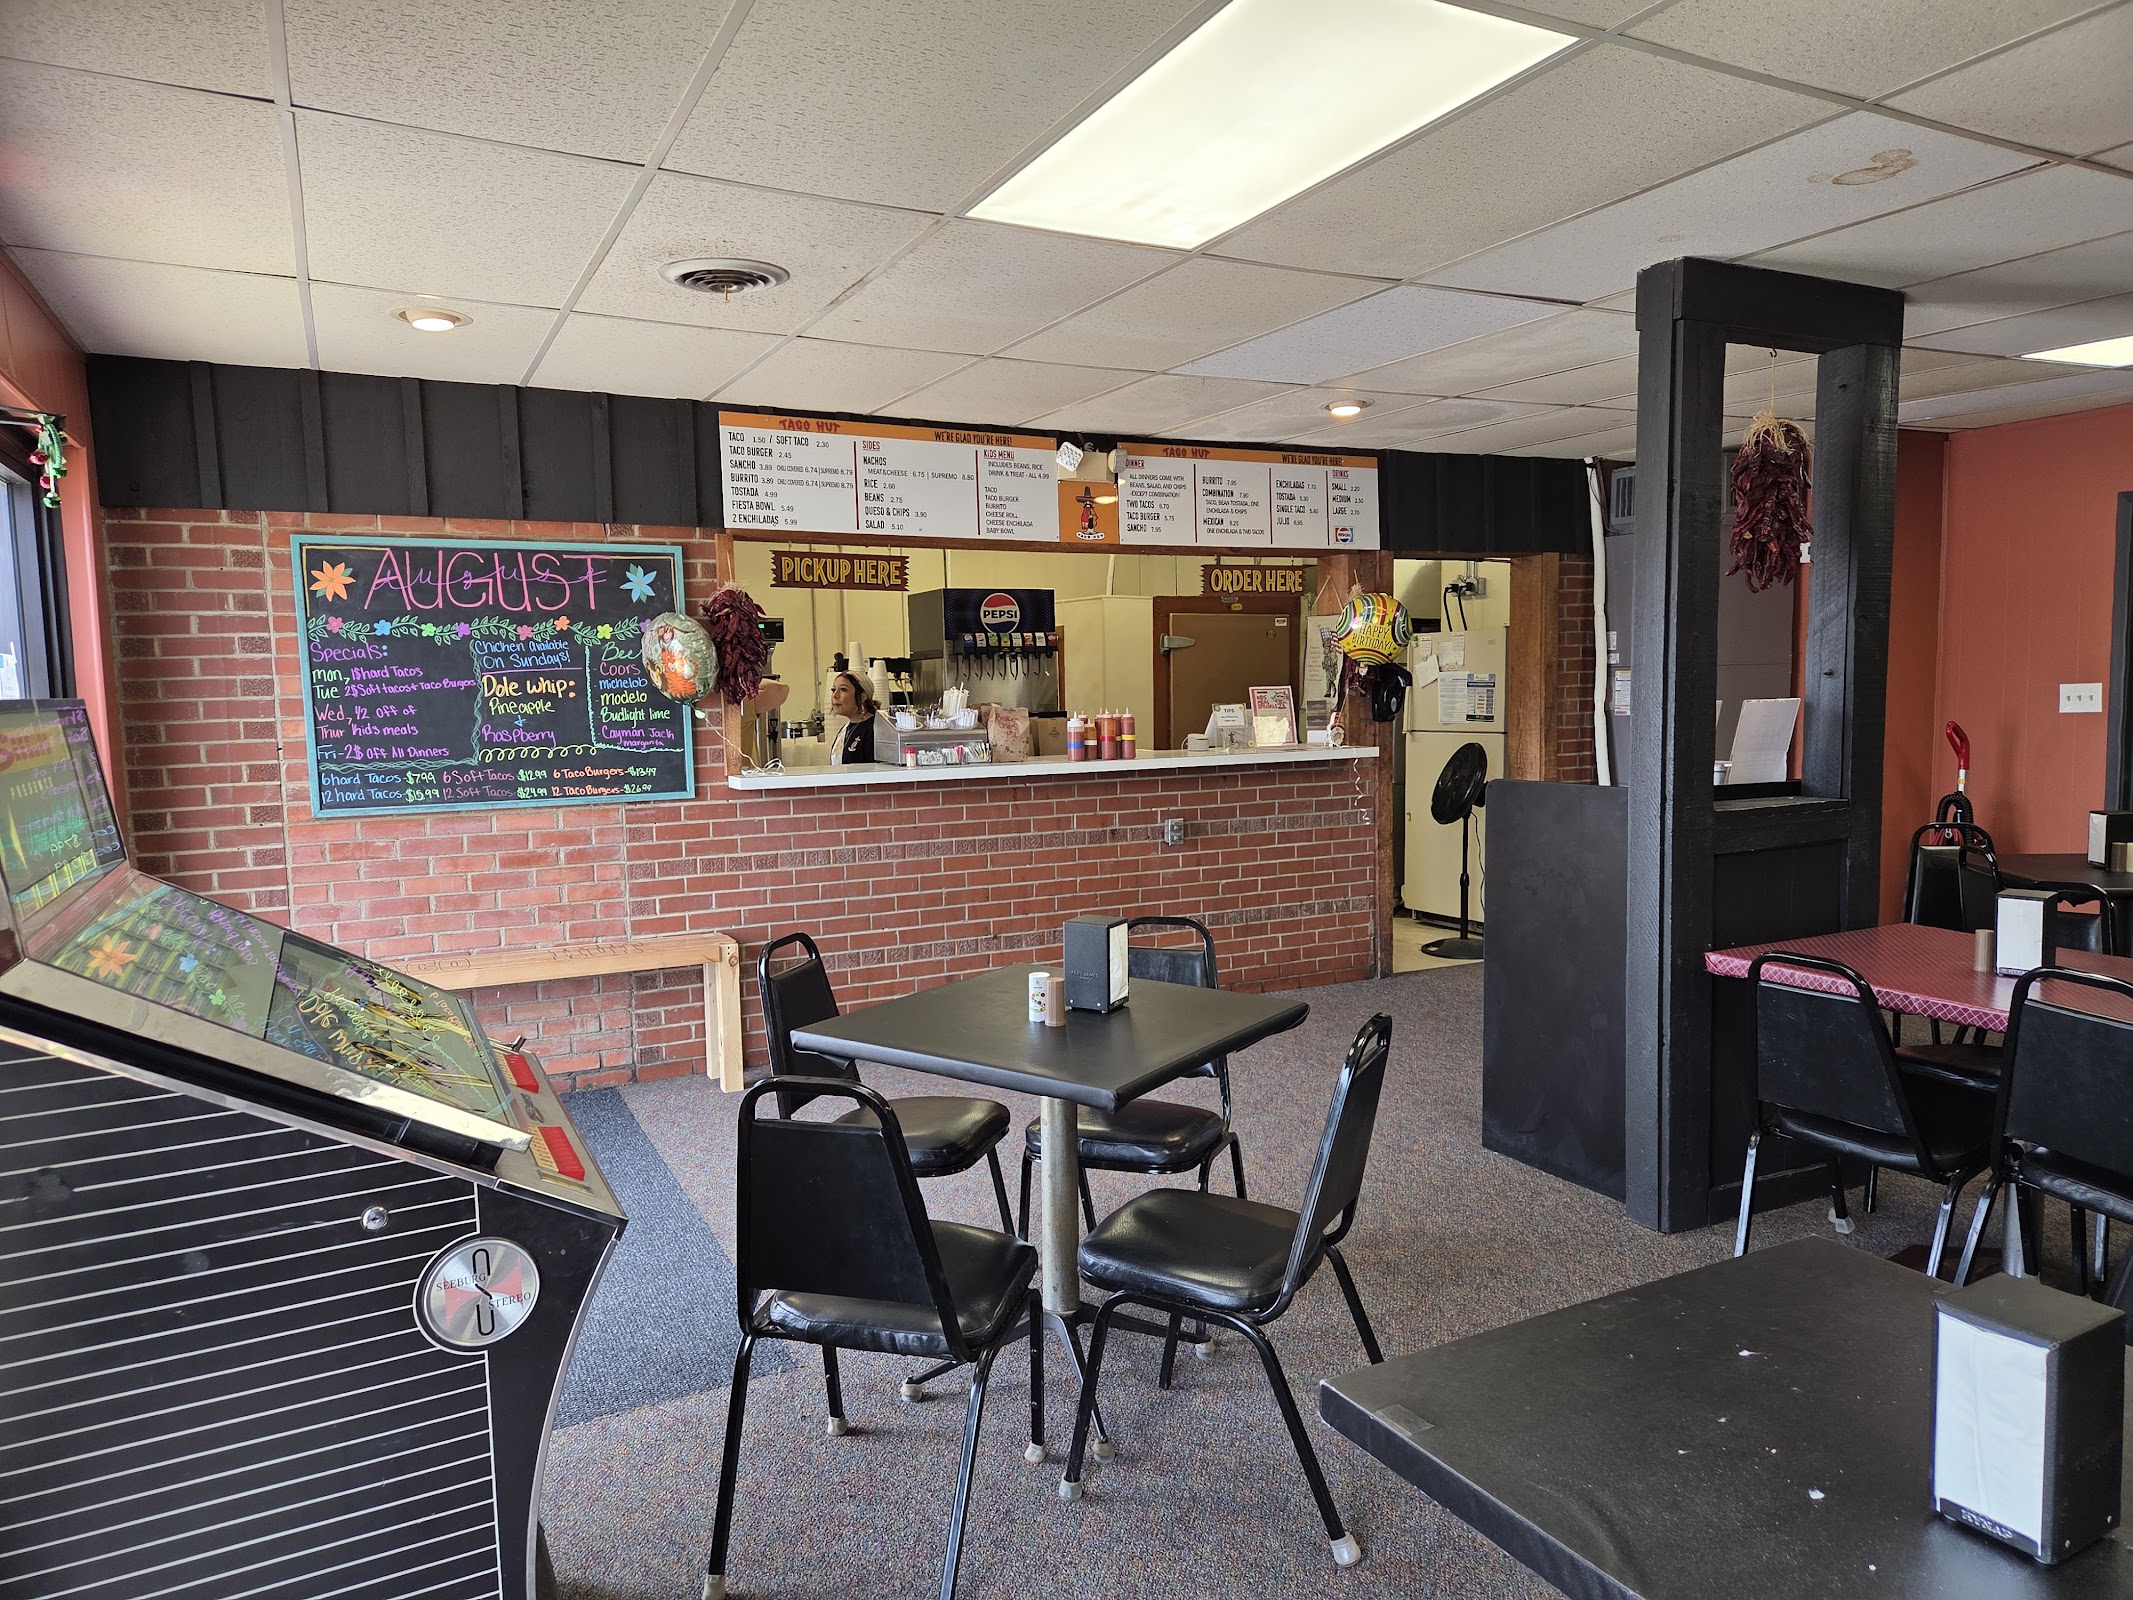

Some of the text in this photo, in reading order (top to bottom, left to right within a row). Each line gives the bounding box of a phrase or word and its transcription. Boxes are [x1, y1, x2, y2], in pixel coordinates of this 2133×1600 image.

[779, 418, 841, 433] TACO HUT
[728, 431, 745, 442] TACO
[752, 436, 766, 444] 1.50
[776, 435, 792, 446] SOFT
[793, 436, 809, 447] TACO
[934, 430, 1012, 446] WE'RE GLAD YOU'RE HERE!
[862, 440, 880, 450] SIDES
[729, 445, 792, 459] TACO BURGER 2.45
[983, 448, 1015, 460] KIDS MENU
[1162, 447, 1211, 459] TACO HUT
[863, 455, 887, 466] NACHOS
[988, 461, 1043, 471] INCLUDES RICE
[730, 459, 853, 476] SANCHO 3.89 6.74 8.79
[988, 469, 1004, 477] DRINK
[730, 473, 759, 484] BURRITO
[761, 477, 774, 485] 3.89
[931, 472, 958, 480] SUPREMO
[864, 478, 878, 489] RICE
[984, 486, 998, 494] TACO
[731, 486, 759, 497] TOSTADA
[864, 492, 903, 504] BEANS 2.75
[985, 494, 1019, 503] TACO BURGER
[732, 500, 794, 513] FIESTA BOWL 5.49
[864, 506, 885, 516] QUESO
[892, 507, 910, 517] CHIPS
[985, 502, 1007, 510] BURRITO
[732, 513, 798, 526] 2 ENCHILADAS 5.99
[865, 519, 885, 529] SALAD
[1127, 523, 1147, 532] SANCHO
[781, 557, 902, 587] PICKUP HERE
[364, 548, 611, 612] AUGUST
[1211, 569, 1303, 594] ORDER HERE
[983, 610, 1018, 619] PEPSI
[1360, 623, 1390, 639] HAPPY
[474, 640, 526, 655] Chicken
[1351, 632, 1393, 651] BIRTHDAY!
[310, 642, 388, 663] Specials:
[482, 651, 571, 669] On Sundays!
[390, 665, 424, 678] Tacos
[599, 662, 641, 676] Coors
[312, 684, 341, 699] Tue
[482, 675, 523, 698] Dole
[402, 705, 418, 716] of
[489, 697, 556, 716] Pineapple
[649, 707, 671, 721] lime
[315, 724, 345, 740] Thur
[382, 724, 419, 736] meals
[601, 725, 646, 746] Cayman
[481, 724, 556, 750] Raspberry
[407, 746, 450, 758] Dinners
[451, 769, 485, 785] Soft
[552, 769, 561, 779] 6
[321, 791, 334, 804] 12
[335, 788, 365, 802] hard
[442, 788, 455, 800] 12
[454, 786, 480, 800] Soft
[551, 787, 563, 797] 12
[436, 1272, 487, 1292] SEEBURG
[488, 1292, 531, 1310] STEREO
